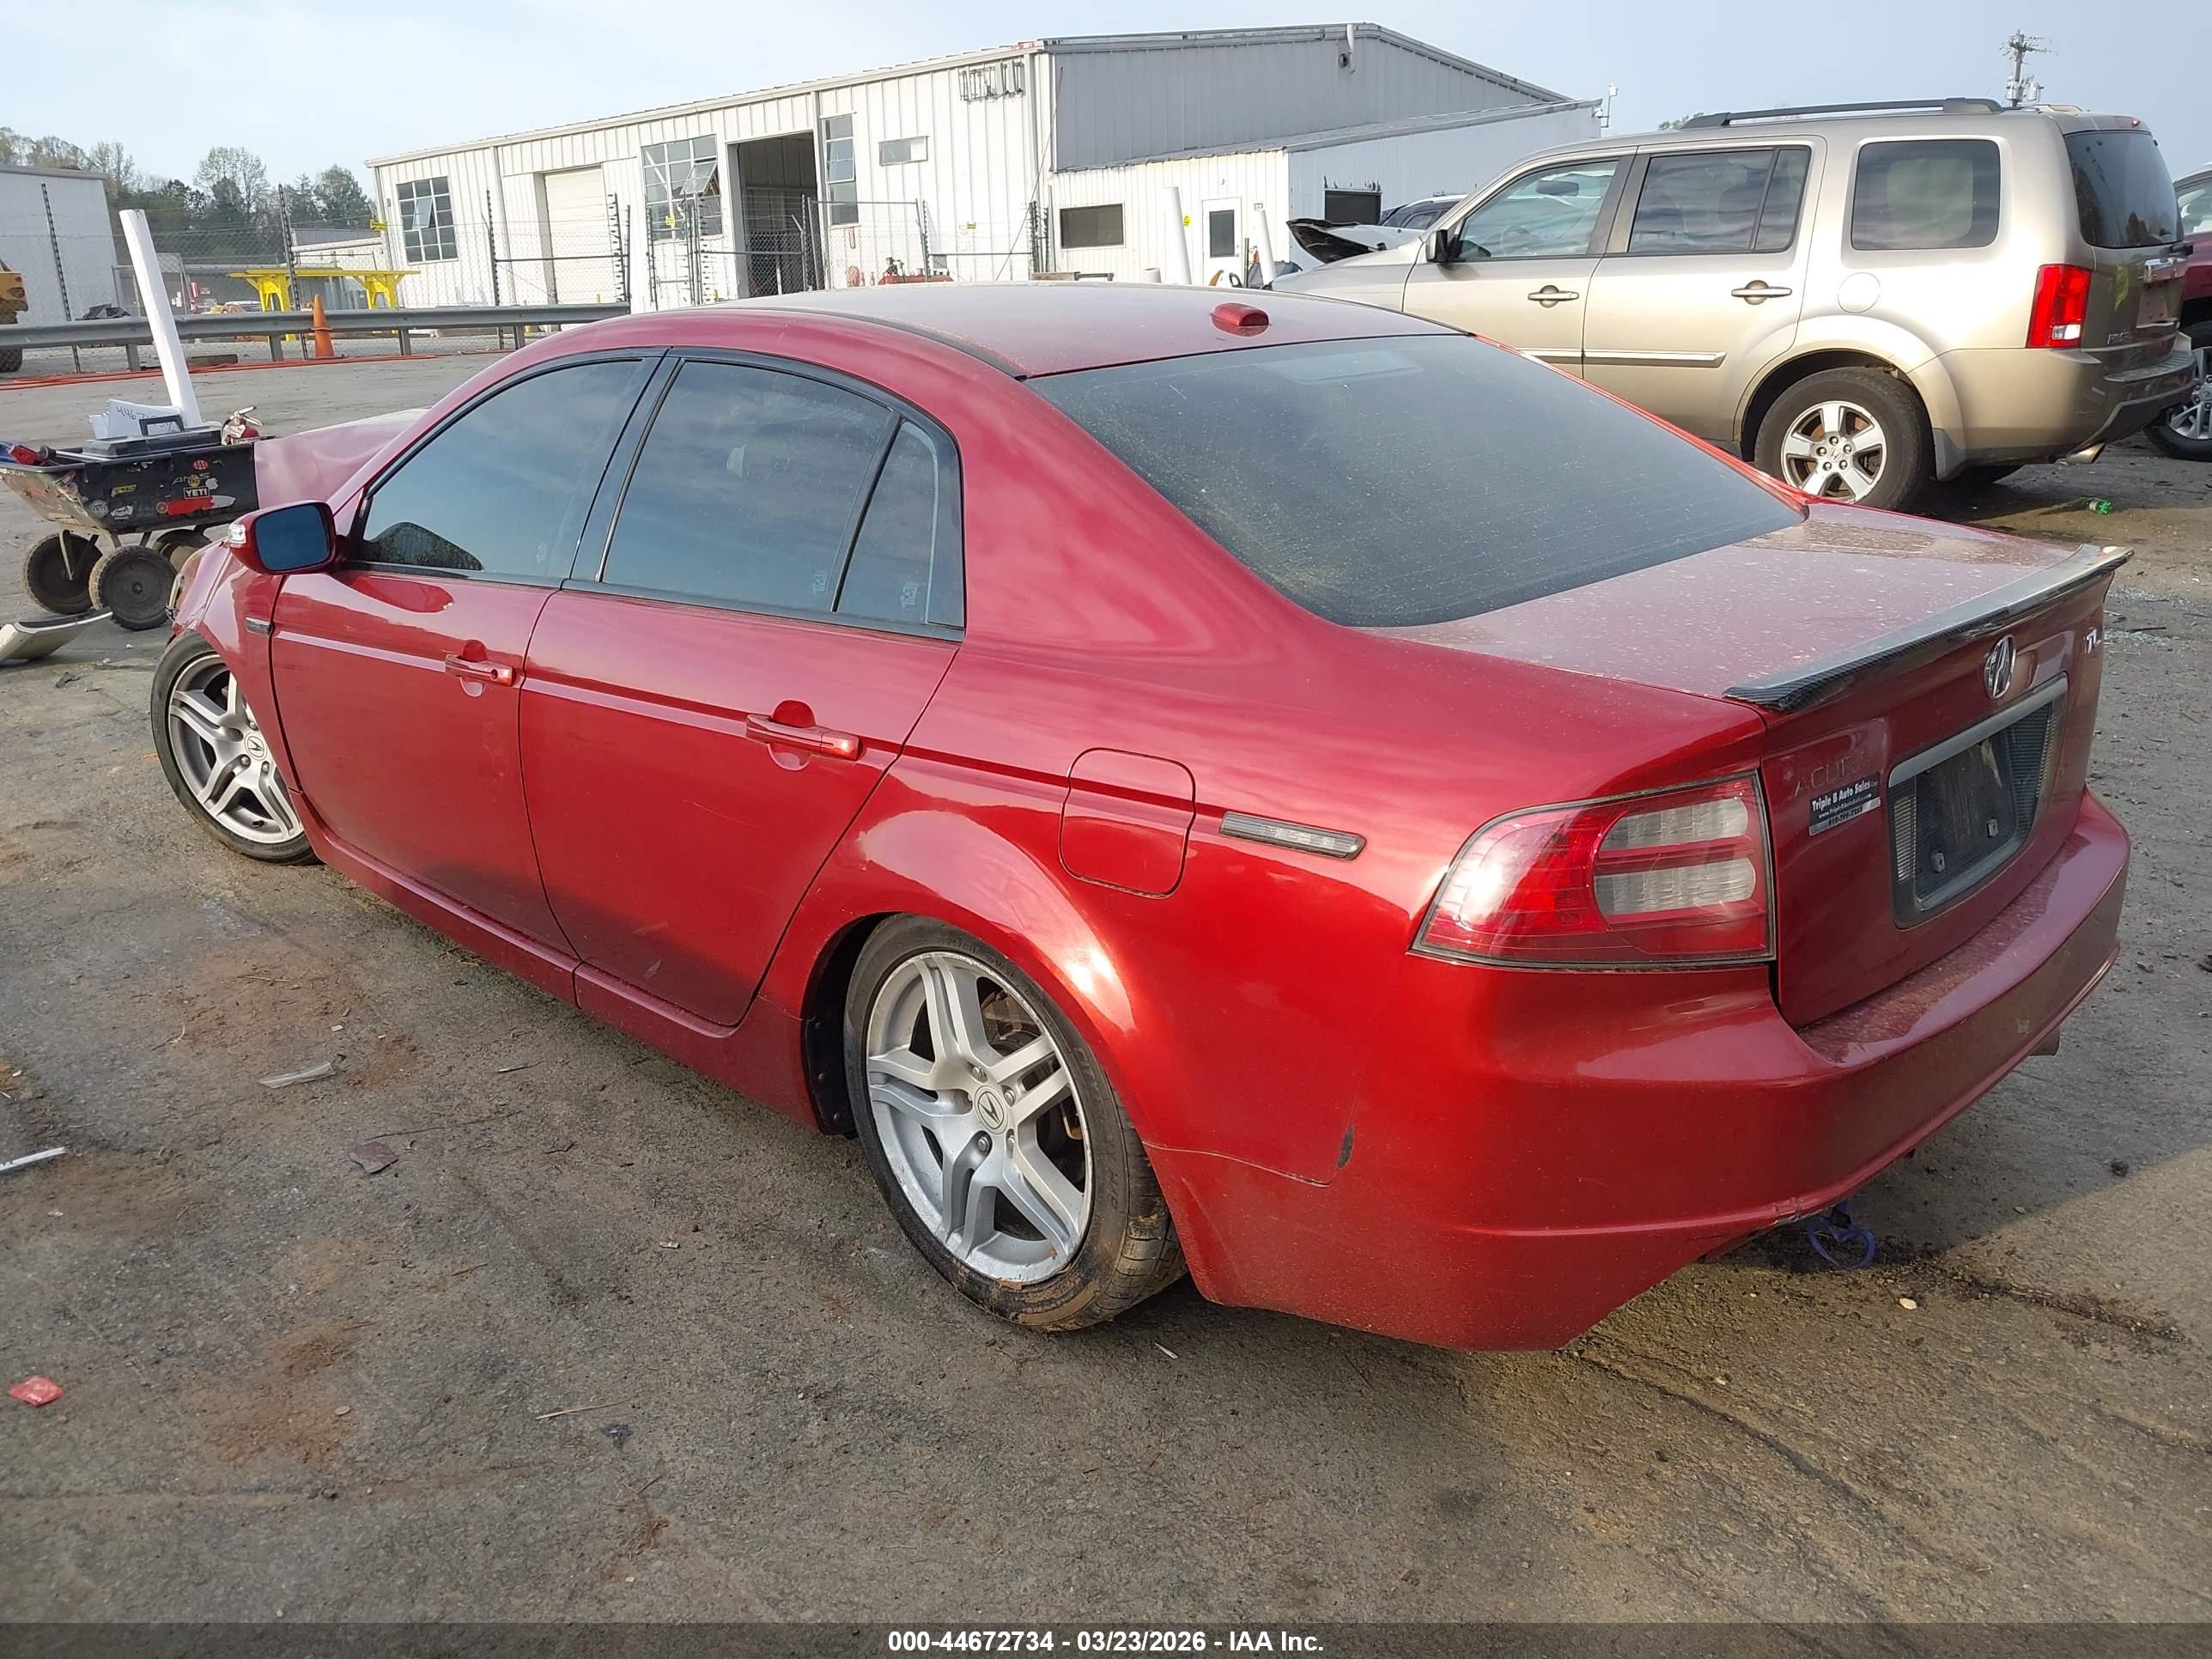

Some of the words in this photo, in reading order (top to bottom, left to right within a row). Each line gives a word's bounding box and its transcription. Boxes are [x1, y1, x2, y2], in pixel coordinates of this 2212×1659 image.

[185, 489, 207, 497] YETI
[1812, 795, 1832, 811] Triple
[1832, 793, 1838, 804] B
[1838, 787, 1854, 801] Auto
[1855, 780, 1870, 794] Sales
